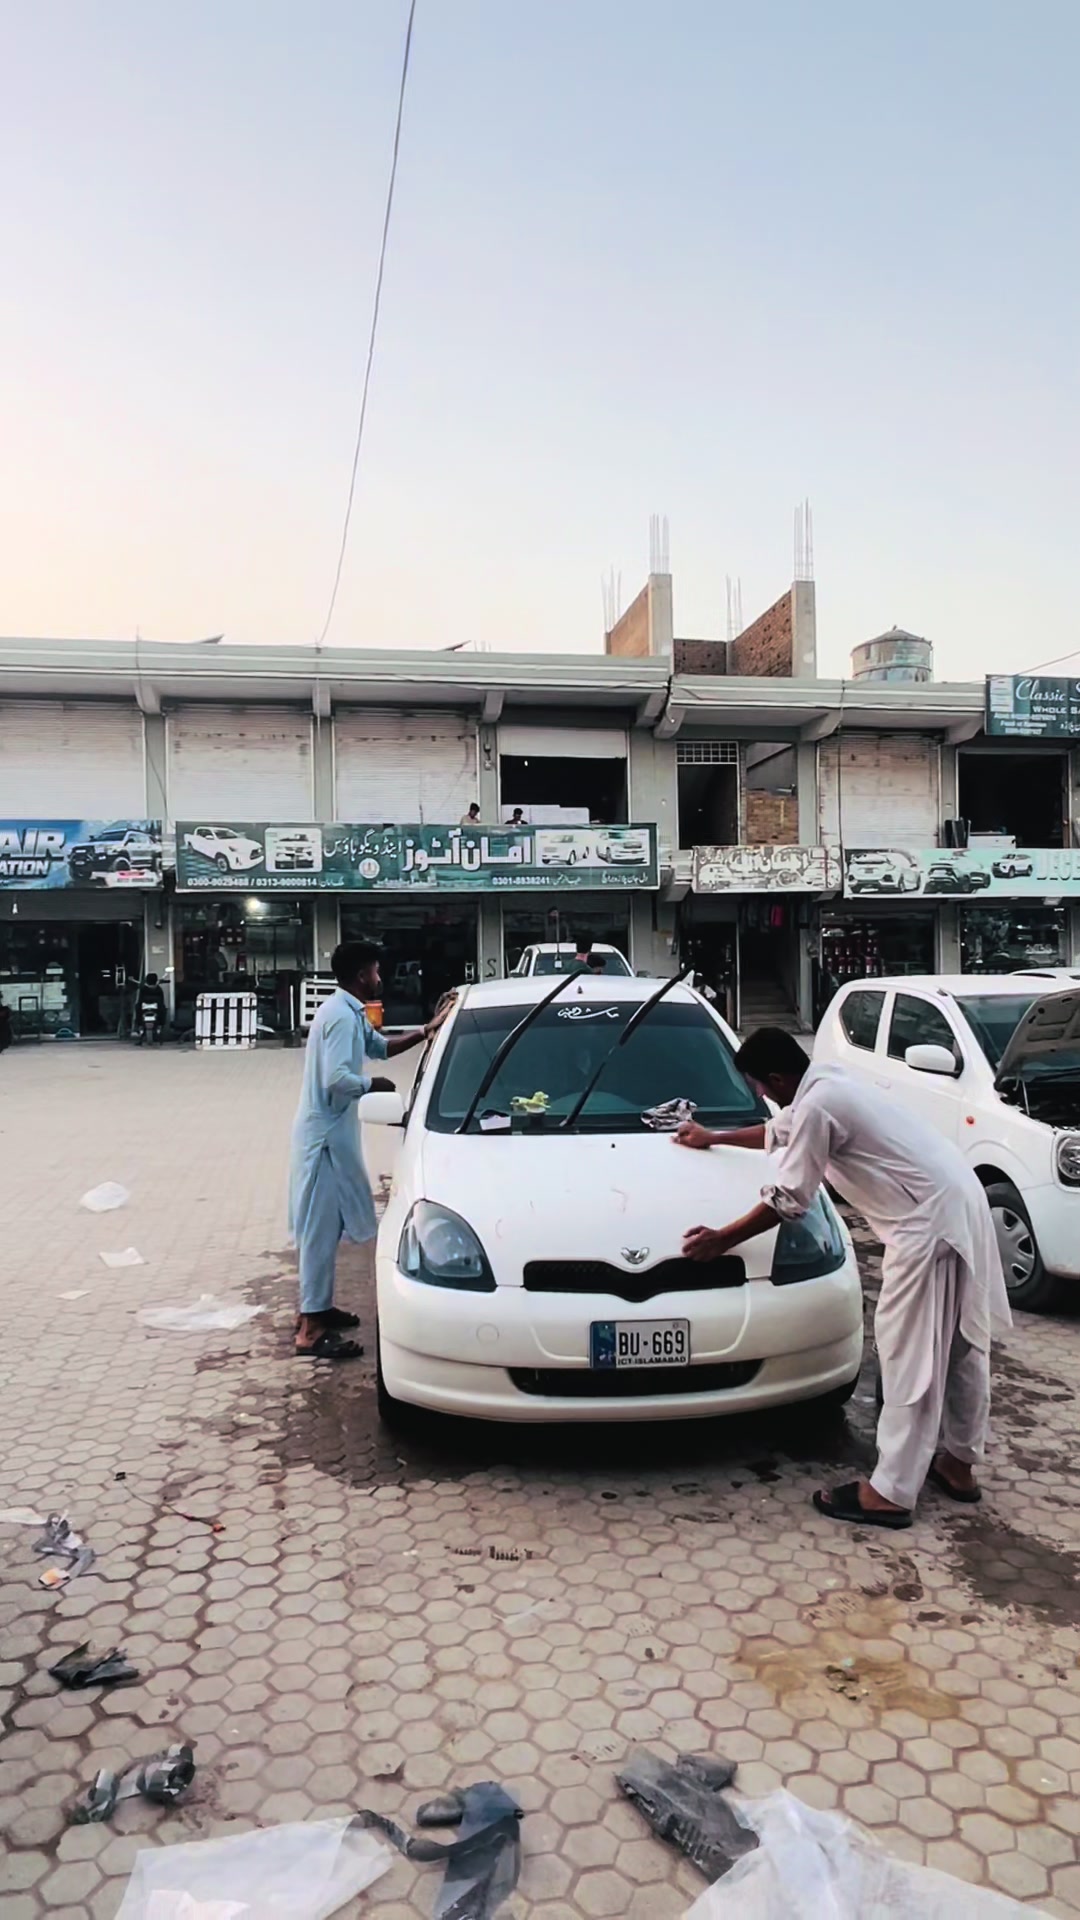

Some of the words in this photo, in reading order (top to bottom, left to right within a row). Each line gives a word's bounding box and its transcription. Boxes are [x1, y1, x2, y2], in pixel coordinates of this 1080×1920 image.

[1015, 678, 1067, 702] Classic
[1032, 705, 1067, 715] WHOLE
[461, 836, 533, 871] امان
